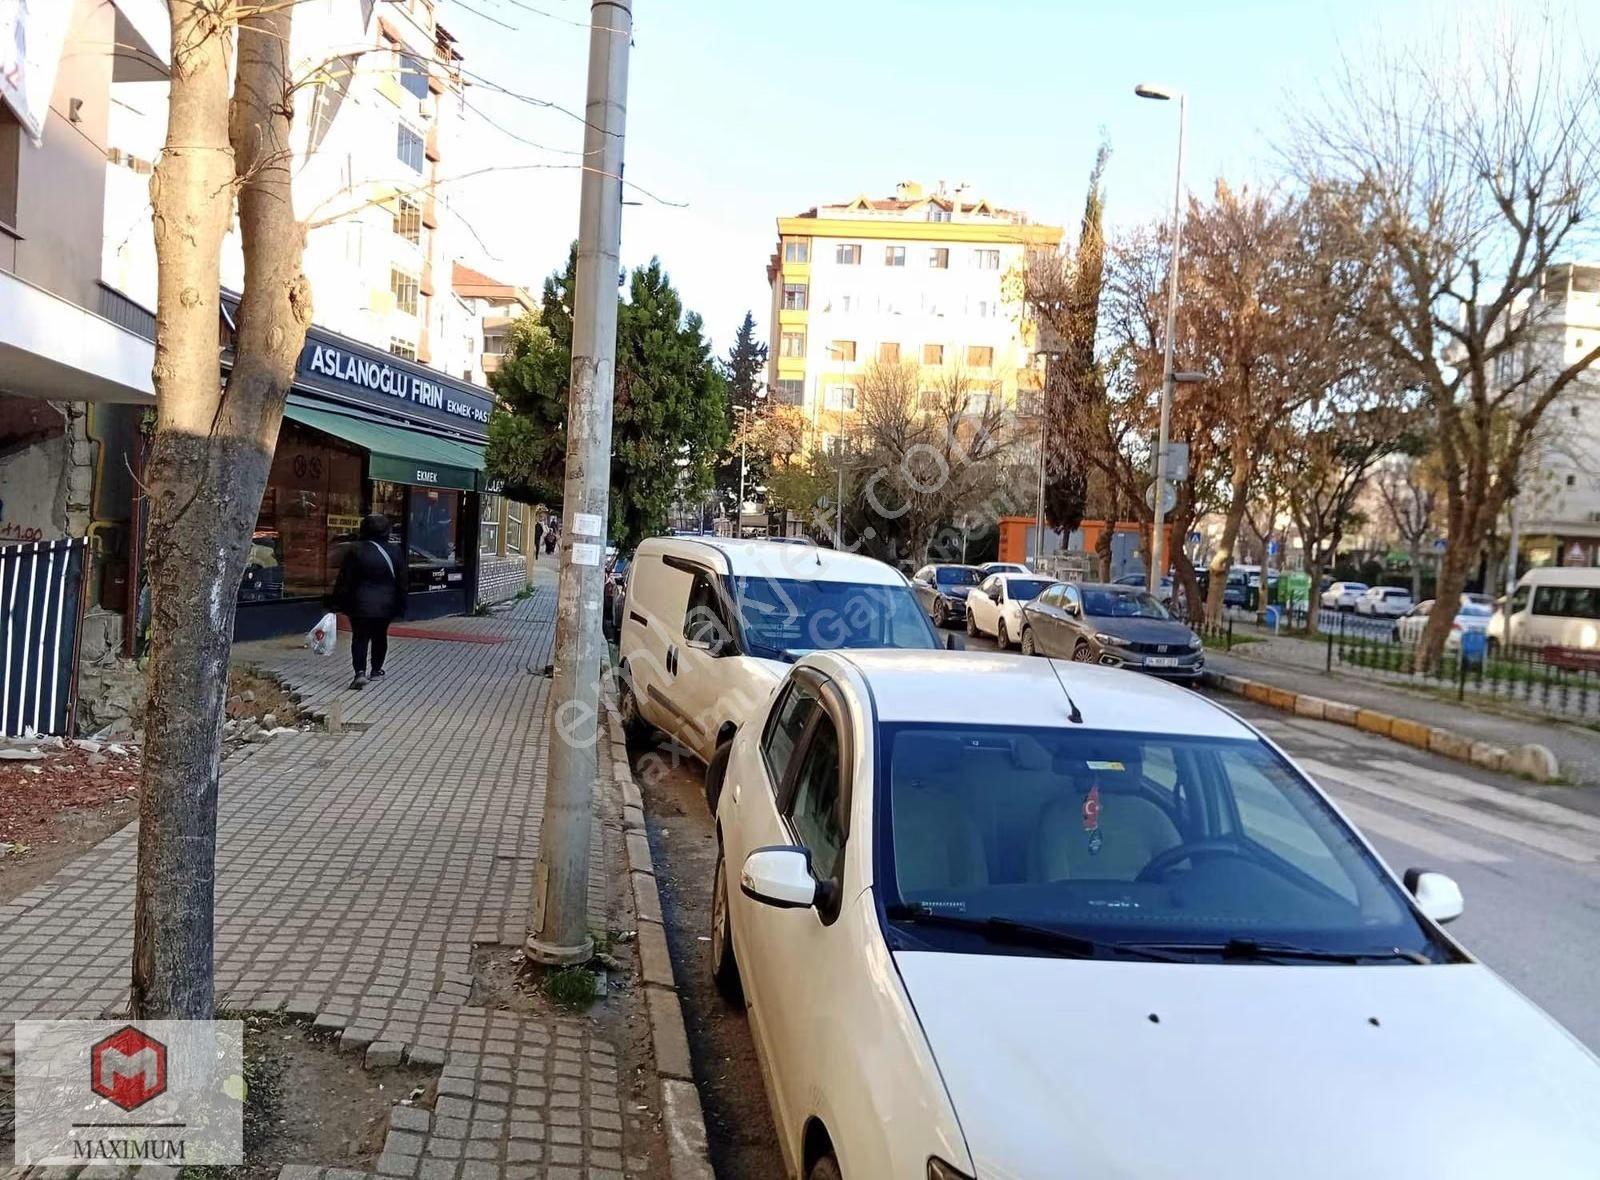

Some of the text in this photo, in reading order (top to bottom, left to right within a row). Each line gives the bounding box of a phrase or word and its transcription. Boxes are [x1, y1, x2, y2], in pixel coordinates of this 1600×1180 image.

[310, 345, 408, 399] ASLANOĞLU
[411, 378, 444, 410] FIRIN
[416, 470, 438, 483] EKMEK
